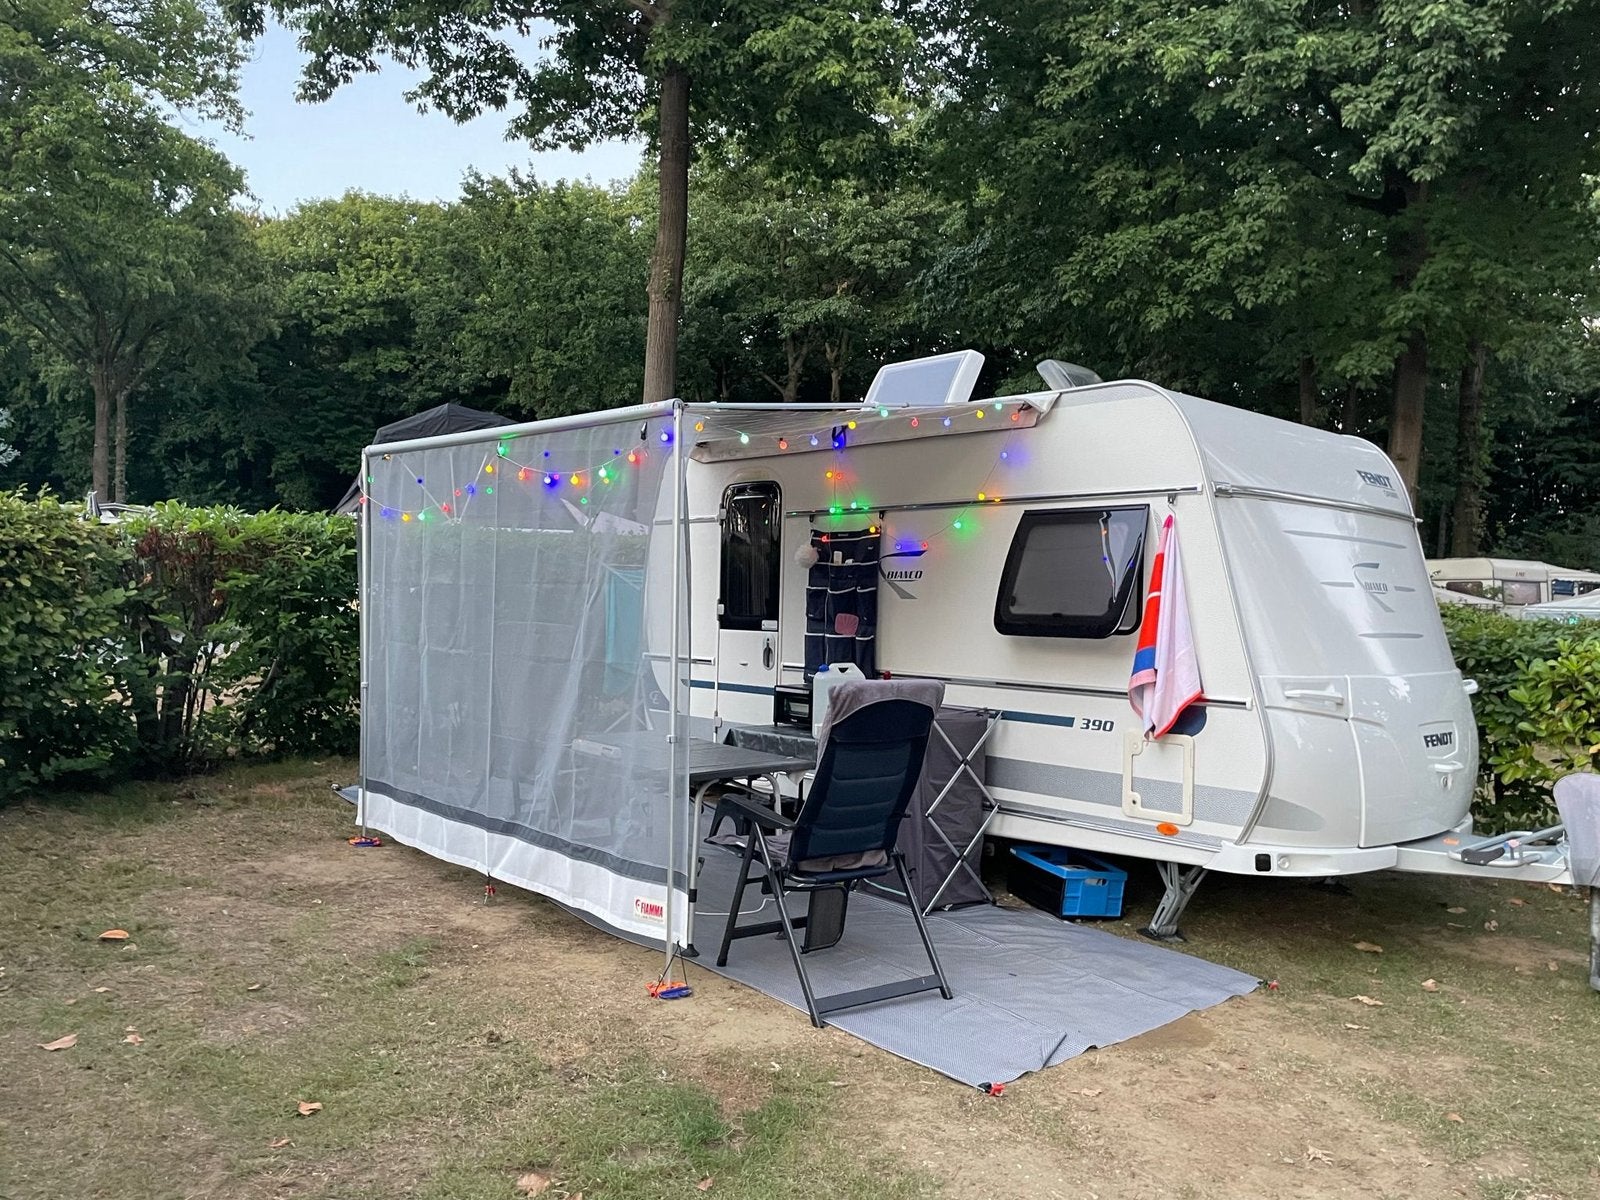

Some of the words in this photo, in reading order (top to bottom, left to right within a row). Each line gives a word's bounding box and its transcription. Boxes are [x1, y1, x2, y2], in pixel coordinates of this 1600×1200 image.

[1356, 470, 1393, 489] FENDT
[886, 570, 923, 579] BIANCO
[1079, 717, 1115, 732] 390
[1423, 731, 1453, 748] FENDT
[640, 902, 663, 918] FIAMMA
